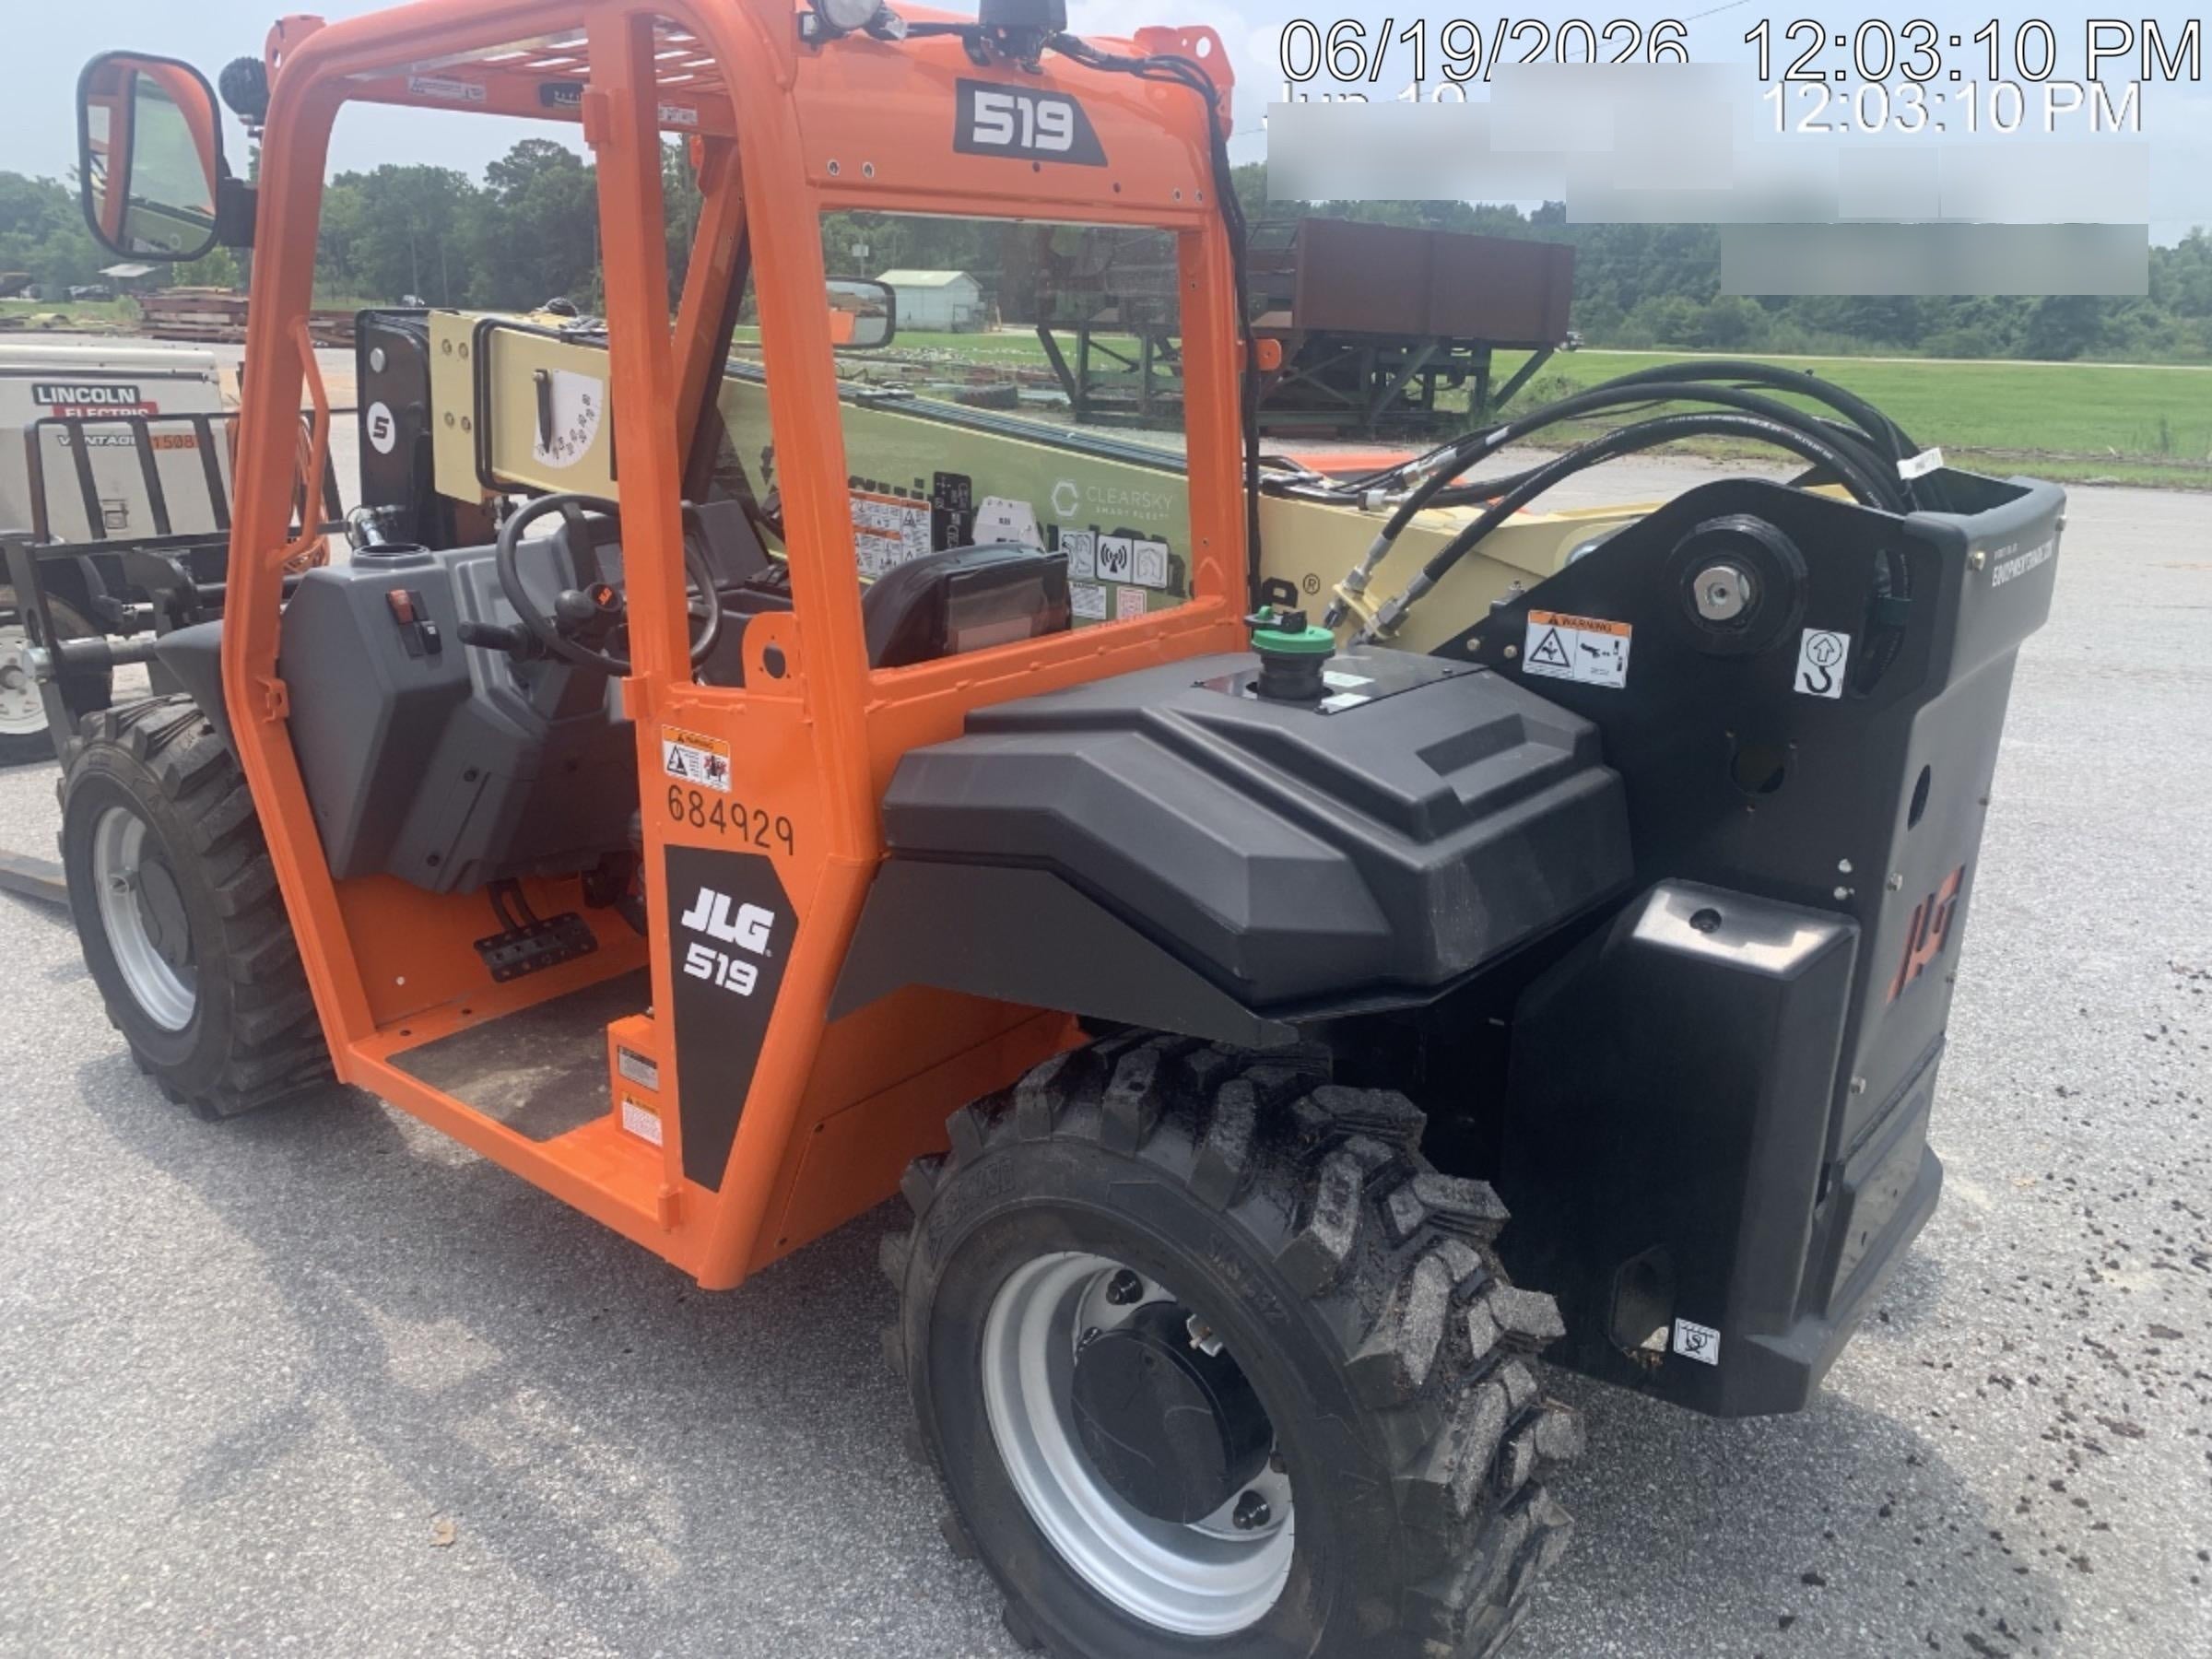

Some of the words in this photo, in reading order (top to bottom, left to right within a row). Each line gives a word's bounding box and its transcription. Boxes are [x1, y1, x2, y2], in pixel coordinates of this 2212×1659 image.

[973, 89, 1074, 152] 519
[37, 385, 135, 404] LINCOLN
[1085, 486, 1173, 510] CLEARSKY
[668, 784, 794, 855] 684929
[681, 887, 775, 955] JLG
[684, 942, 759, 996] 519
